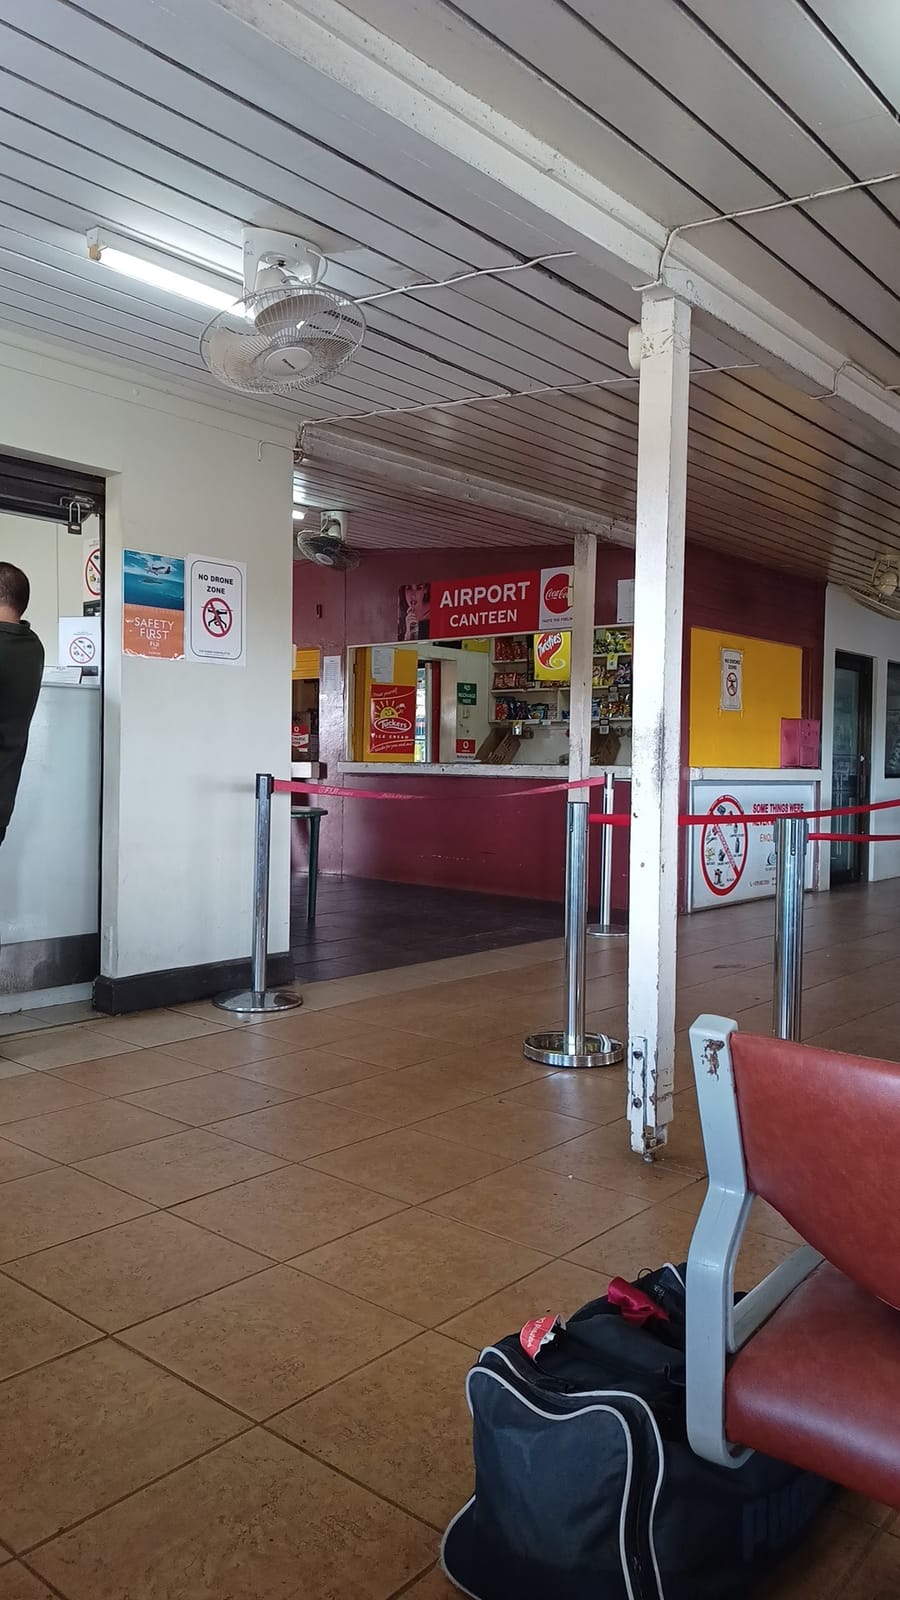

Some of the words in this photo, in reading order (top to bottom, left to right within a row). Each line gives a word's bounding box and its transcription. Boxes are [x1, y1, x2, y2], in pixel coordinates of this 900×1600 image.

[198, 573, 209, 581] NO
[210, 576, 234, 585] DRONE
[206, 586, 226, 595] ZONE
[440, 581, 530, 609] AIRPORT
[134, 616, 175, 631] SAFETY
[449, 609, 518, 627] CANTEEN
[139, 628, 170, 641] FIRST
[378, 718, 408, 729] Tuckers
[752, 803, 769, 813] SOME
[770, 803, 789, 813] THINGS
[789, 803, 804, 812] WERE
